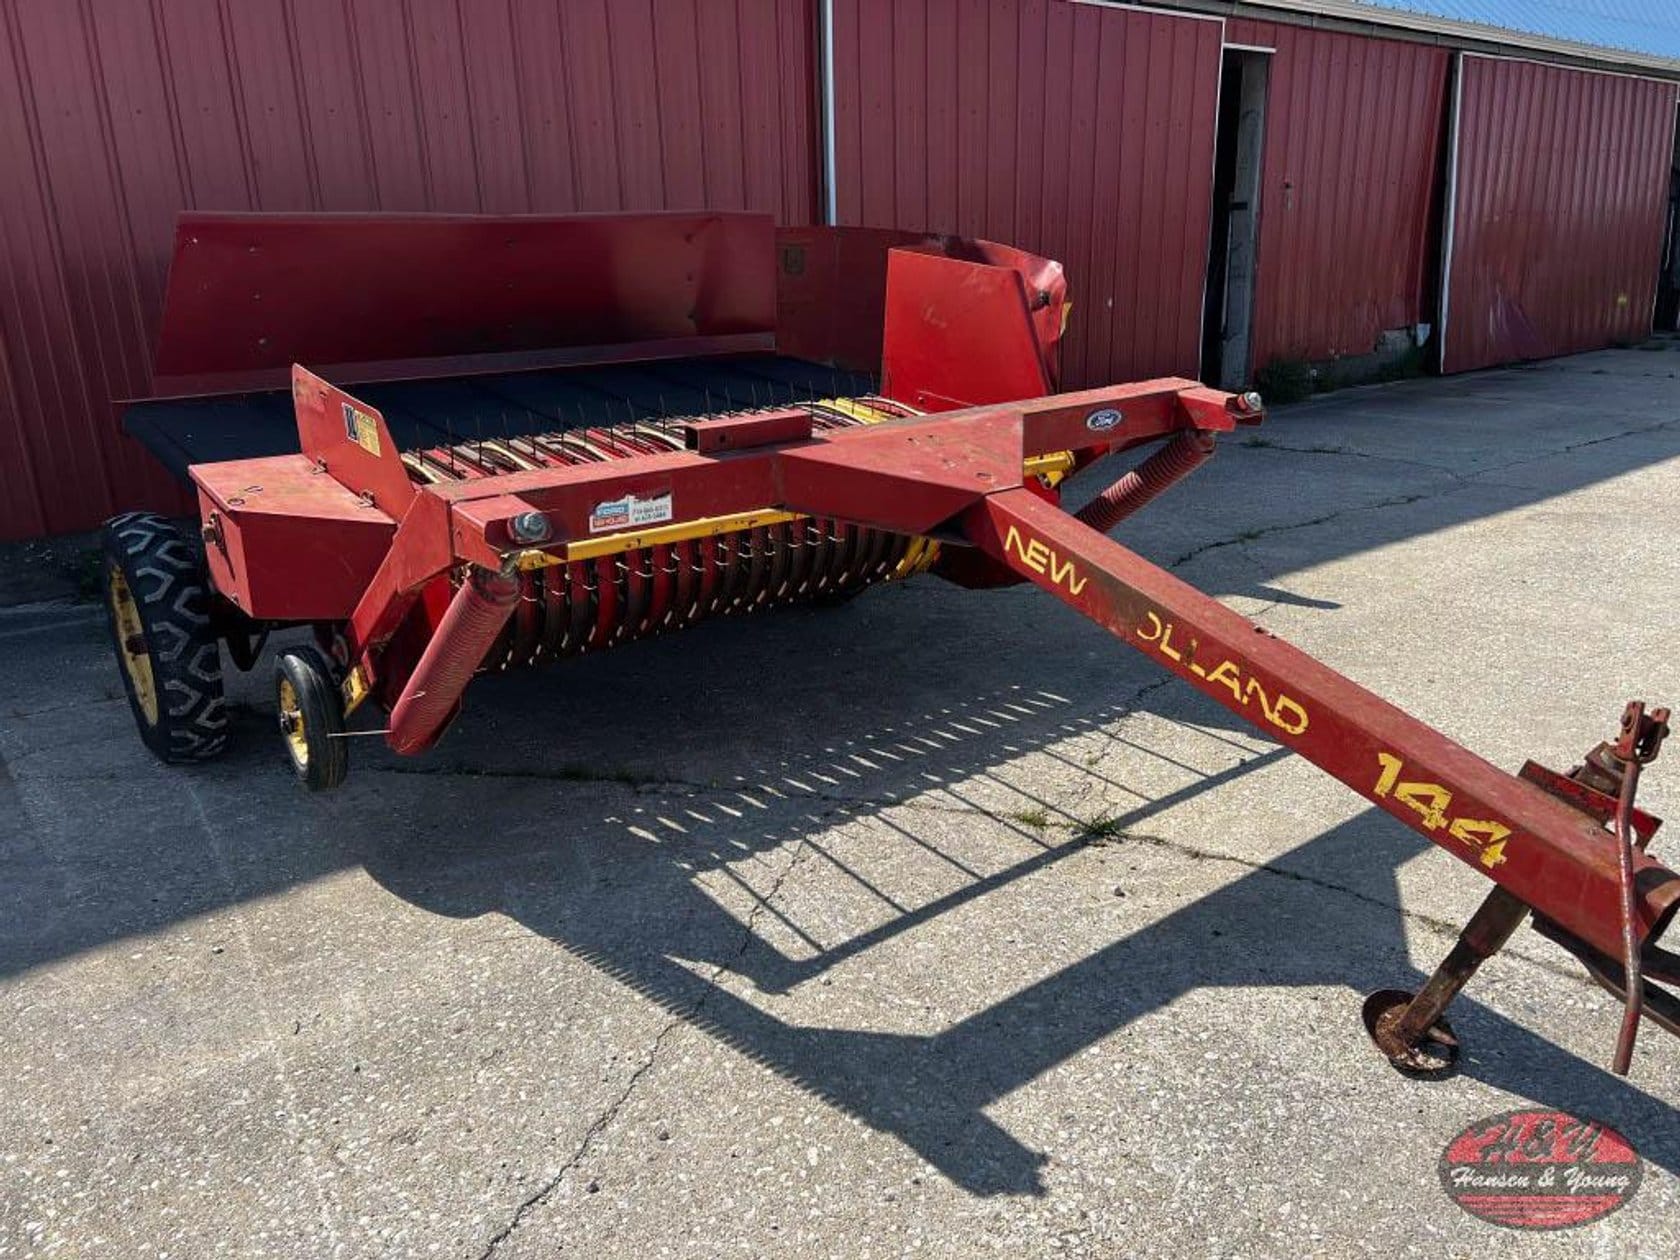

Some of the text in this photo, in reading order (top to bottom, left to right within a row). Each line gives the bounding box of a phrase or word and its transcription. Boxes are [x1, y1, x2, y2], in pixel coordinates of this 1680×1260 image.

[1004, 525, 1512, 869] NEW OLLAND 144
